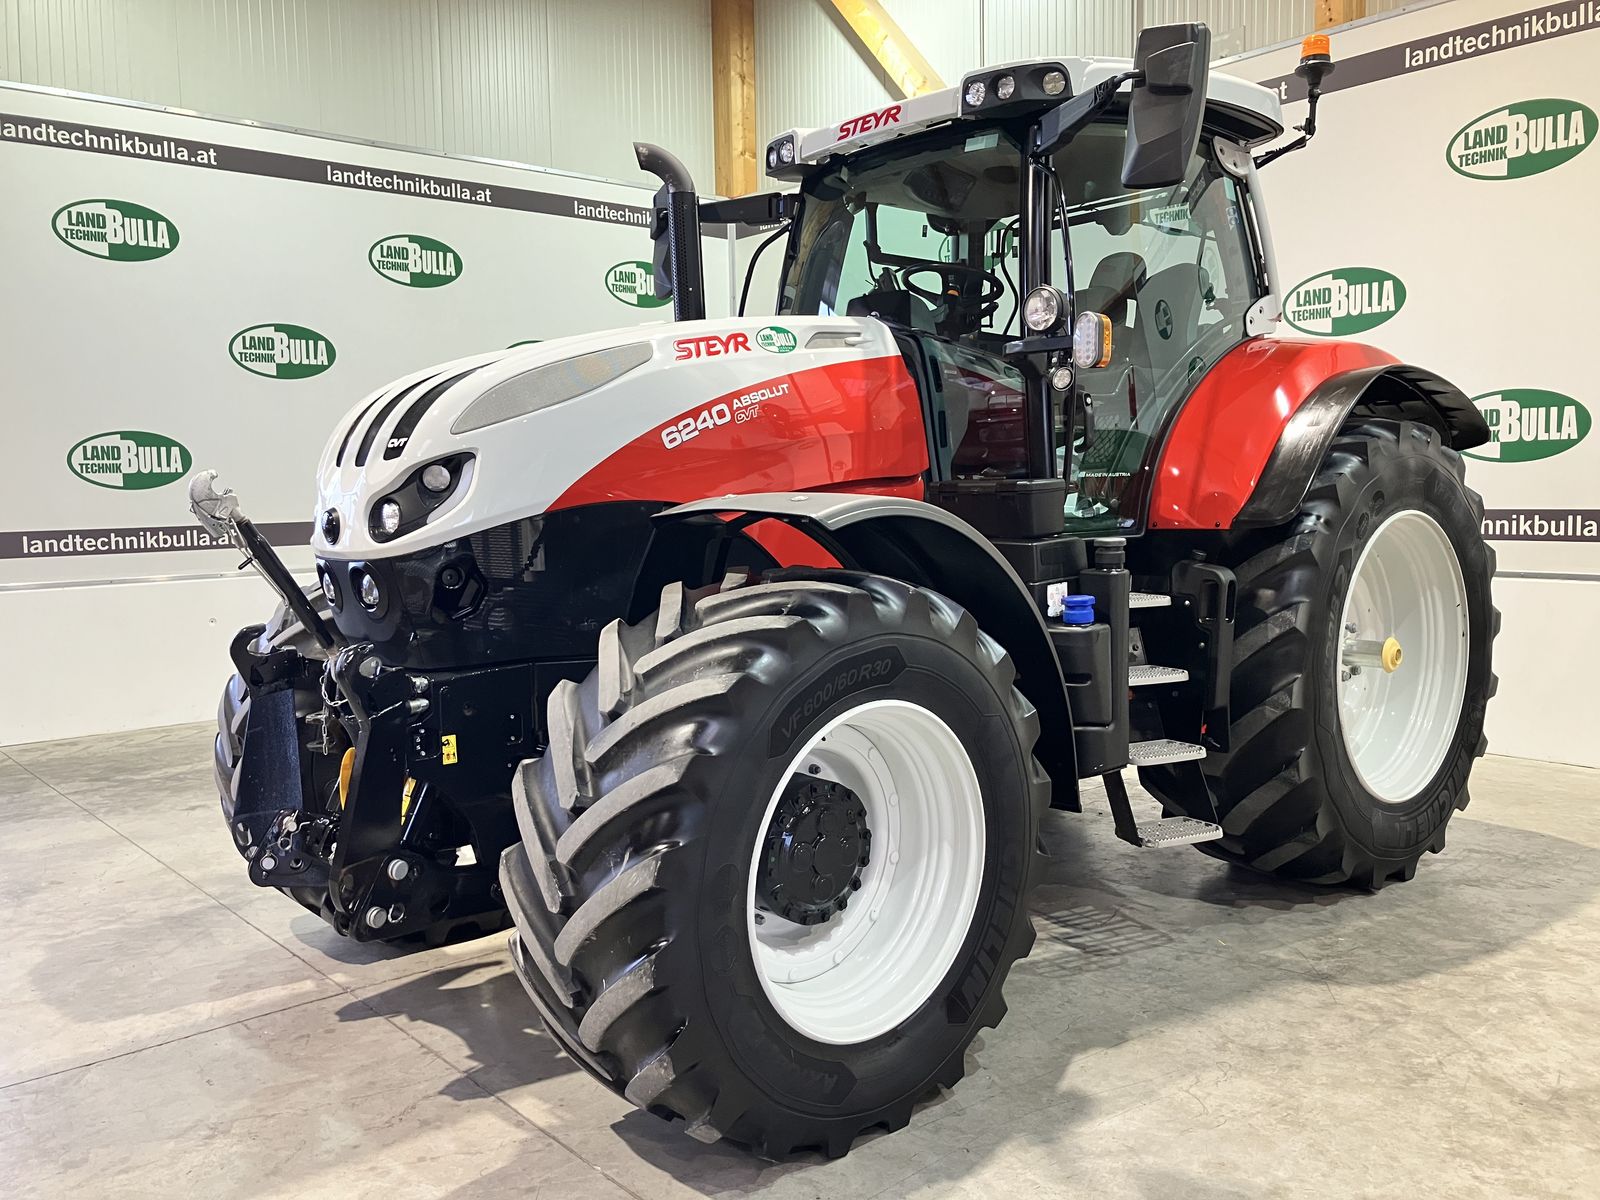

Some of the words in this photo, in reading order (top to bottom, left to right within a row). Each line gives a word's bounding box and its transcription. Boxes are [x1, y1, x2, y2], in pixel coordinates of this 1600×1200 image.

[836, 105, 902, 141] STEYR
[1507, 110, 1585, 156] BULLA
[1463, 125, 1508, 151] LAND
[1458, 147, 1508, 168] TECHNIK
[326, 165, 492, 203] landtechnikbulla.at
[67, 210, 108, 230] LAND
[107, 208, 171, 249] BULLA
[63, 227, 109, 243] TECHNIK
[380, 244, 409, 260] LAND
[408, 242, 456, 276] BULLA
[376, 259, 410, 272] TECHNIK
[614, 270, 637, 284] LAND
[611, 283, 637, 294] TECHNIK
[1331, 279, 1396, 318] BULLA
[1296, 291, 1332, 308] LAND
[1291, 307, 1333, 322] TECHNIK
[242, 335, 275, 351] LAND
[274, 331, 329, 366] BULLA
[673, 333, 752, 361] STEYR
[238, 351, 277, 364] TECHNIK
[733, 384, 789, 411] ABSOLUT
[734, 405, 759, 424] CVT
[1500, 400, 1578, 442] BULLA
[661, 403, 732, 450] 6240
[387, 437, 409, 448] CVT
[82, 445, 121, 461] LAND
[120, 440, 184, 474] BULLA
[78, 462, 122, 474] TECHNIK
